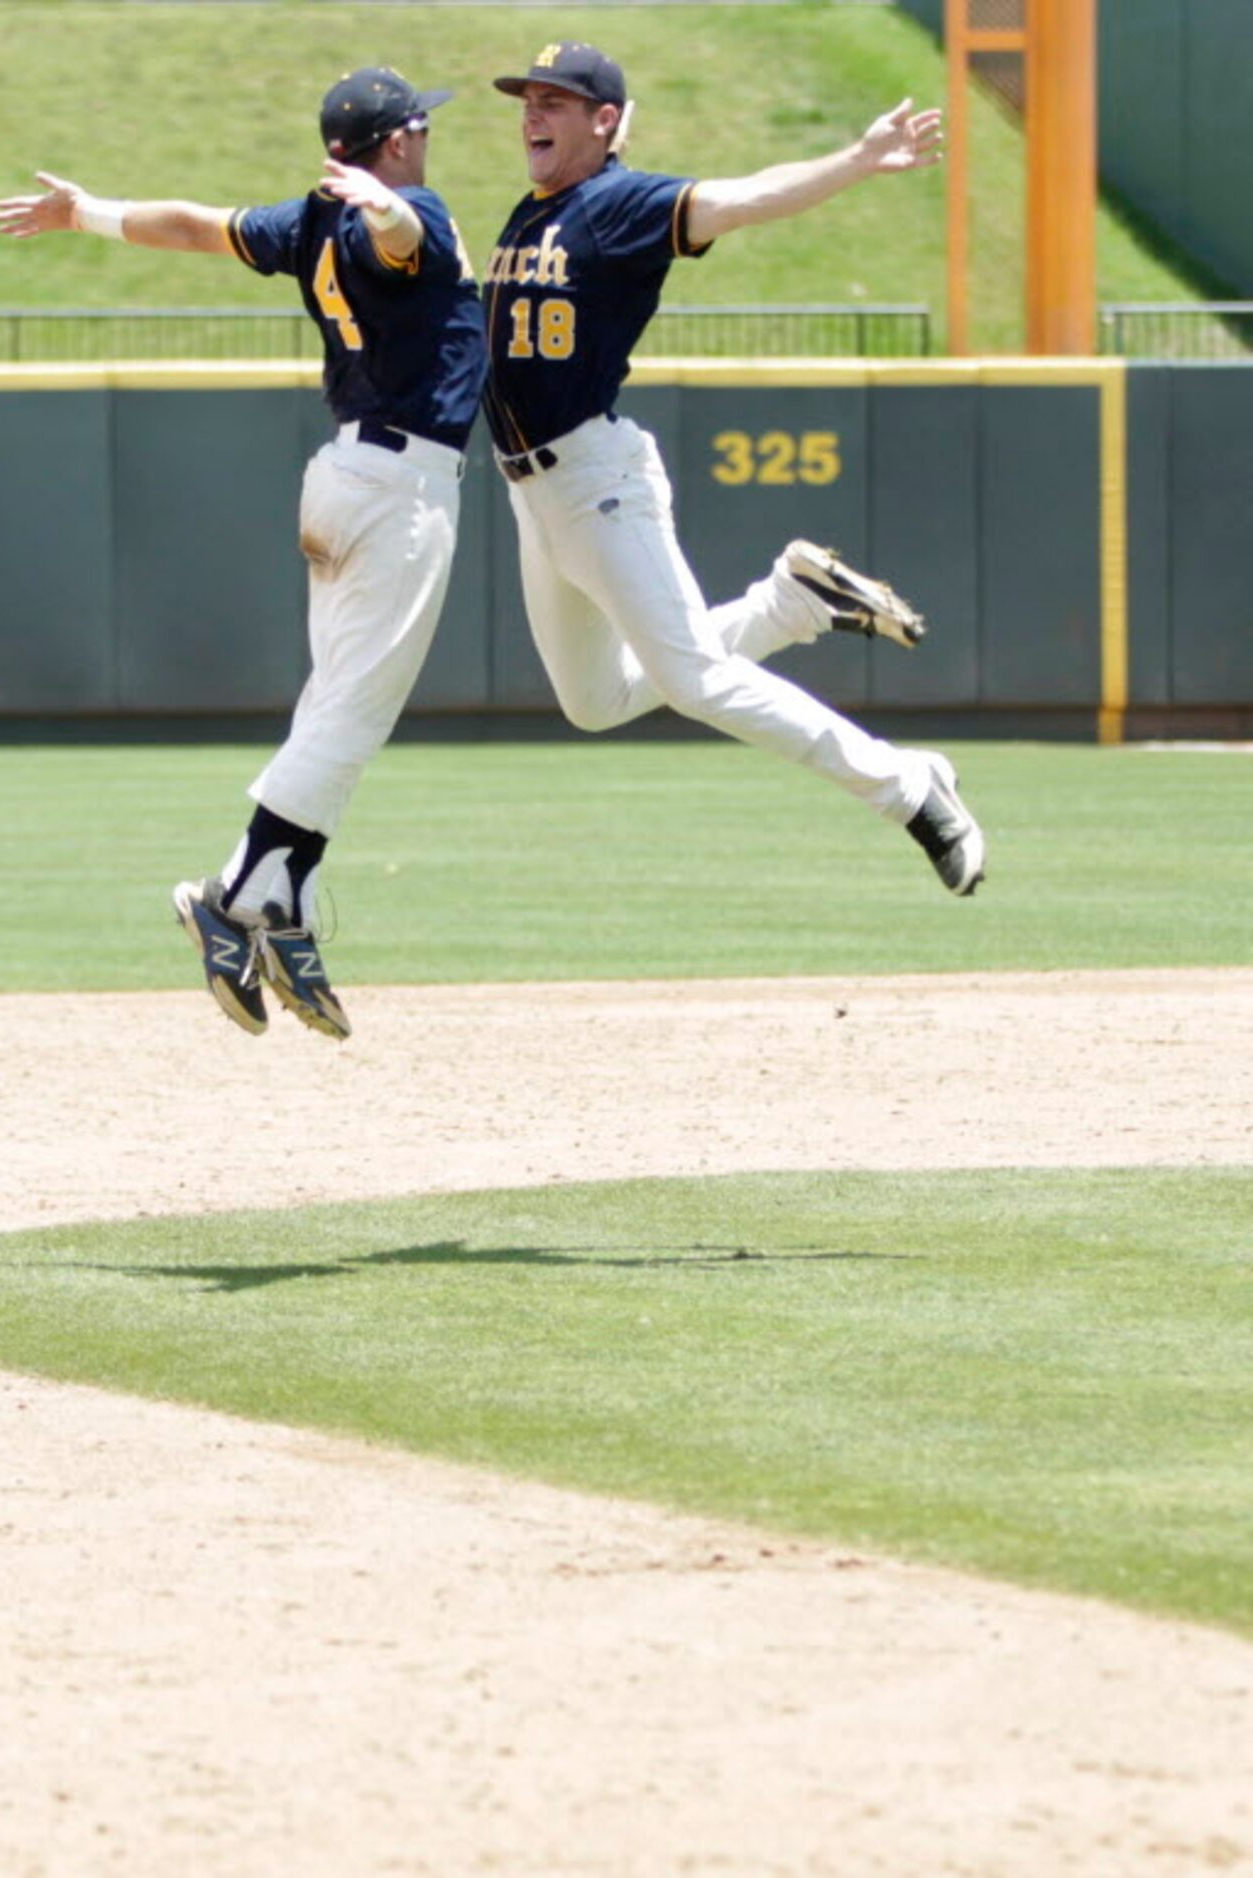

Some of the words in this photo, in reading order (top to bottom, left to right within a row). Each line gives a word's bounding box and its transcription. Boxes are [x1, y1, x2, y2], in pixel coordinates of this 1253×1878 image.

[313, 236, 363, 350] 4
[508, 297, 575, 360] 18
[711, 431, 842, 486] 325
